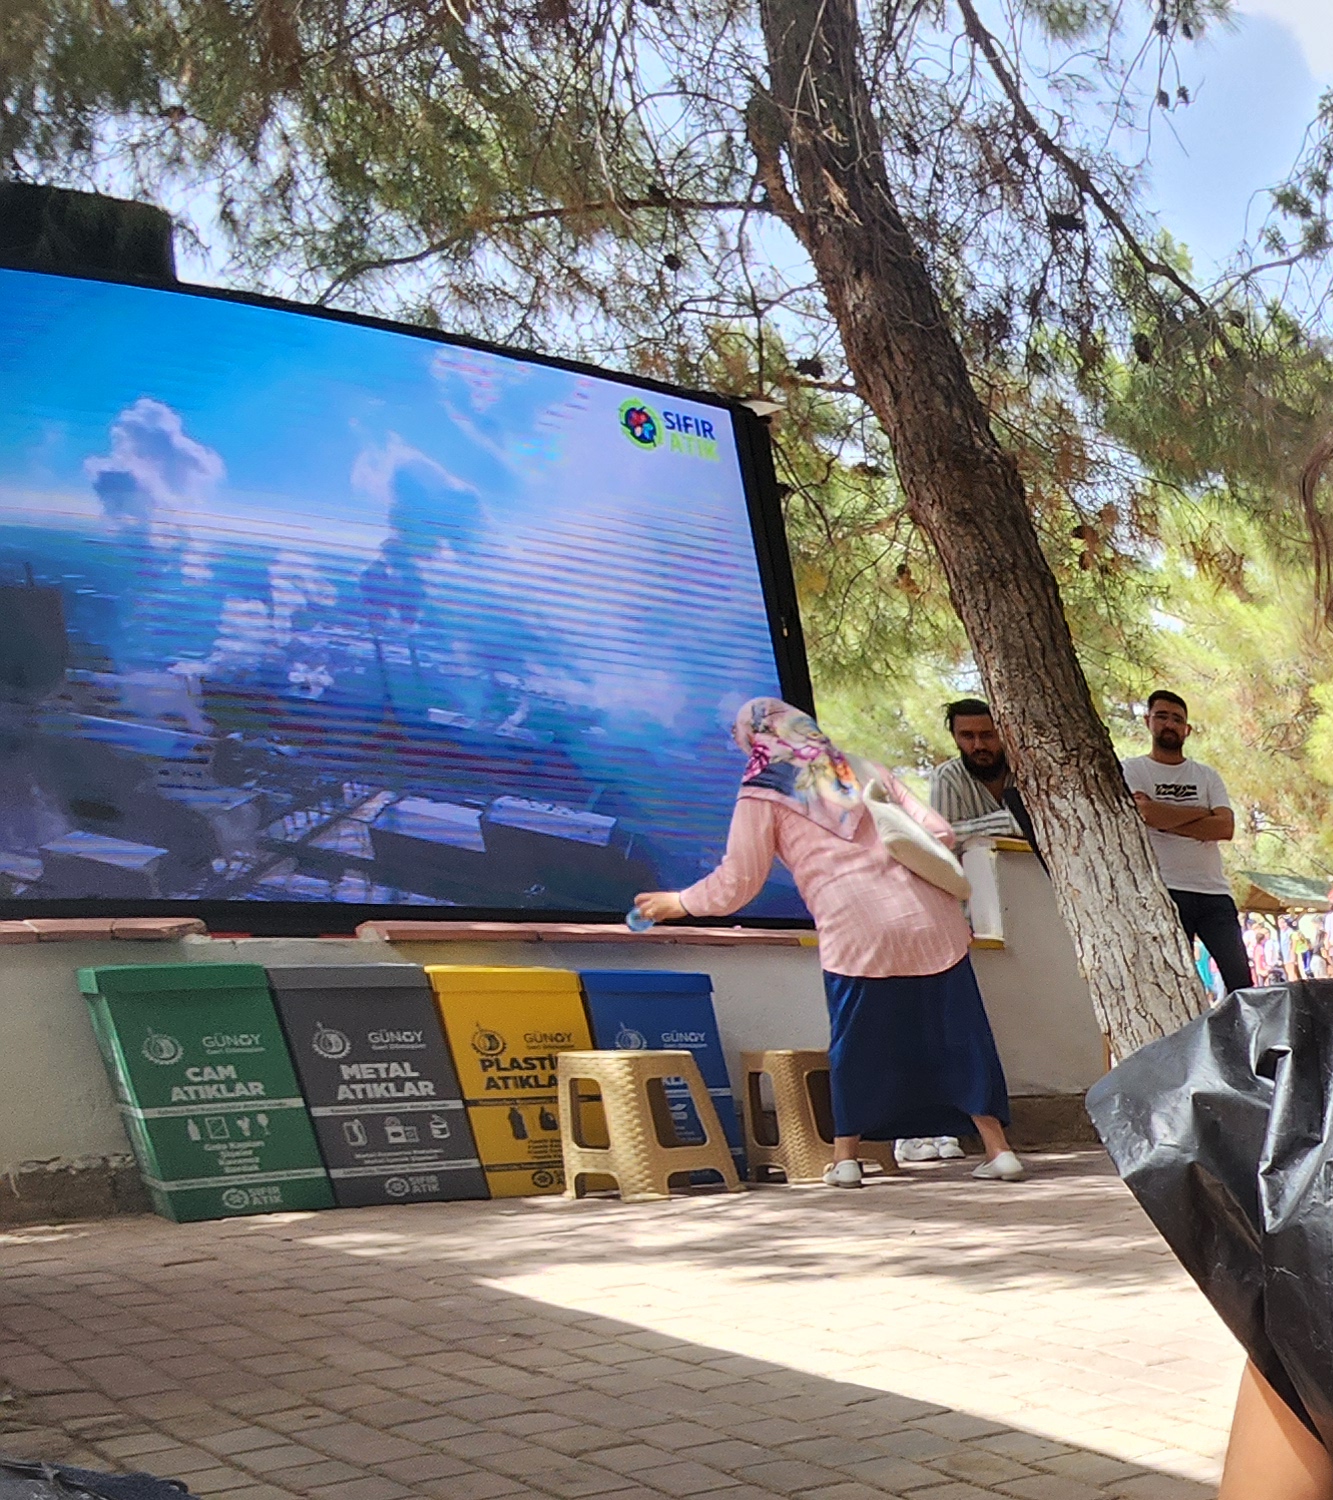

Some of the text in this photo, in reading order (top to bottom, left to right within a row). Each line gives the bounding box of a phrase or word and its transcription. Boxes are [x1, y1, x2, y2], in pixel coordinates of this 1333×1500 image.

[663, 411, 716, 440] SIFIR
[185, 1064, 237, 1081] CAM
[339, 1062, 420, 1080] METAL
[480, 1053, 559, 1073] PLASTİ
[171, 1082, 266, 1101] ATIKLAR
[337, 1081, 436, 1100] ATIKLAR
[485, 1074, 558, 1090] ATIKLA
